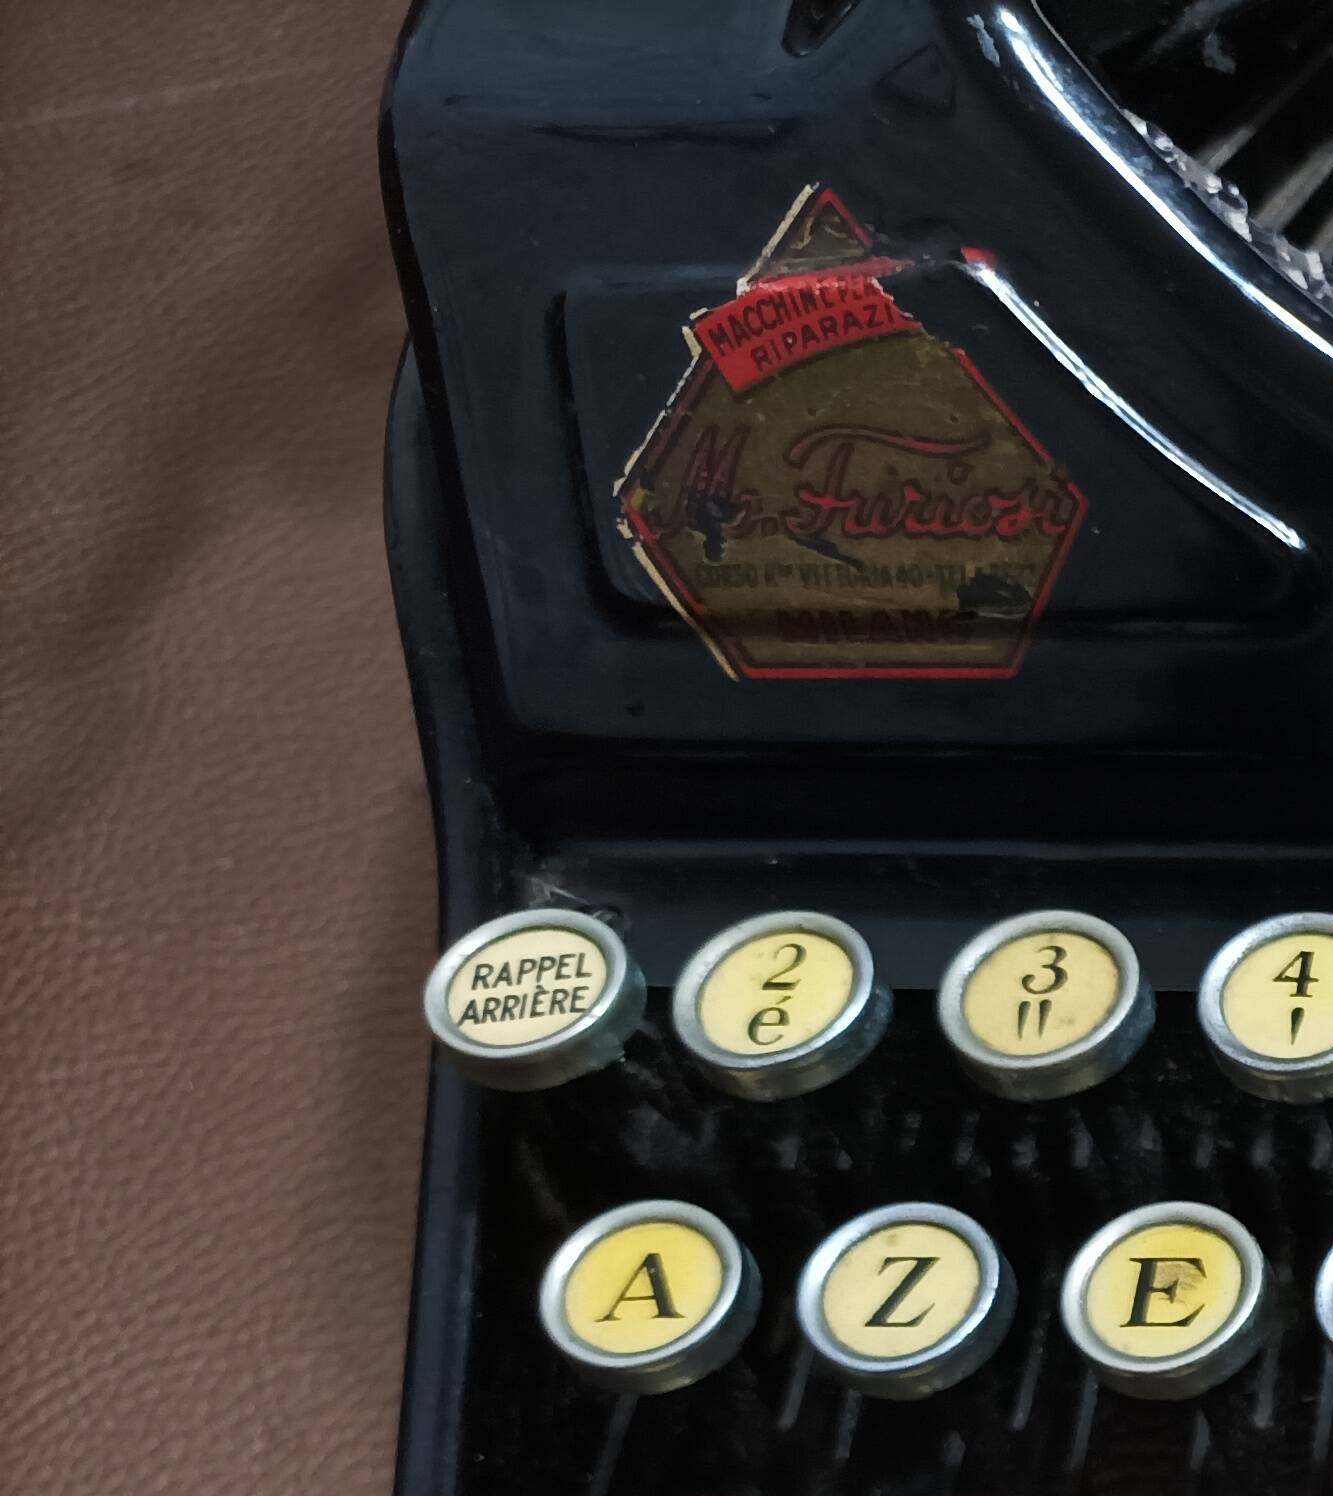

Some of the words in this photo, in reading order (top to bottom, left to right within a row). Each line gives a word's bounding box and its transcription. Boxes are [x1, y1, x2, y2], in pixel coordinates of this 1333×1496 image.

[751, 303, 896, 371] RIPARAZI
[471, 952, 592, 990] RAPPEL
[762, 944, 806, 990] 2
[1022, 946, 1067, 994] 3
[1273, 951, 1318, 997] 4
[457, 984, 590, 1026] ARRIÈRE
[747, 996, 791, 1045] é
[596, 1253, 684, 1322] A
[865, 1257, 940, 1327] Z
[1120, 1258, 1206, 1327] E
